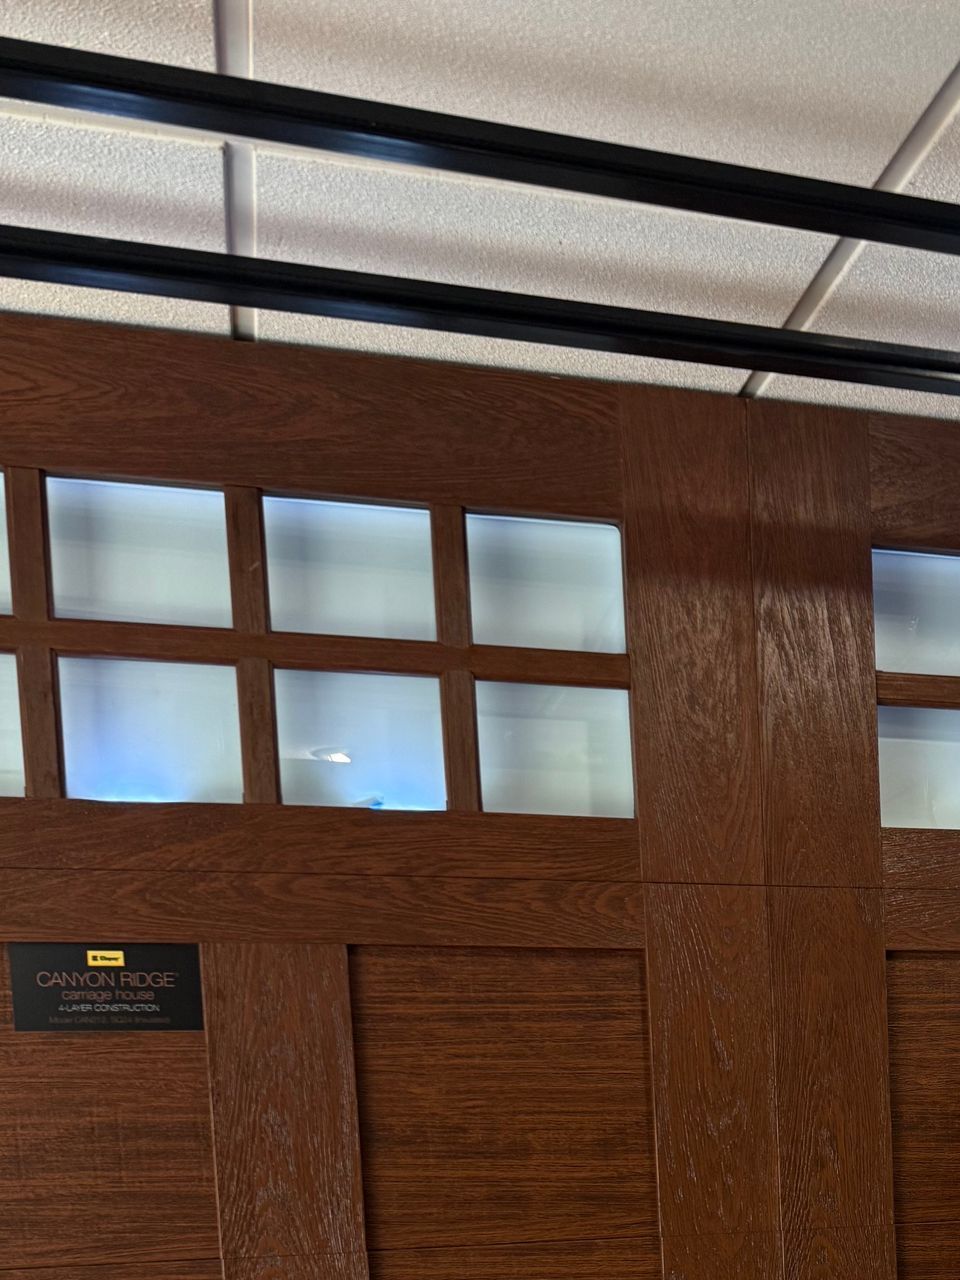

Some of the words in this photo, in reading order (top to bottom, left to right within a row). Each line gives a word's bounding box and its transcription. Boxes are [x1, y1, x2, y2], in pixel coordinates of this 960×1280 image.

[36, 971, 115, 988] CANYON
[120, 971, 176, 988] RIDGE
[61, 989, 112, 1003] carriage
[115, 988, 155, 1001] house
[58, 1003, 93, 1012] 4-LAYER
[94, 1003, 160, 1012] CONSTRUCTION
